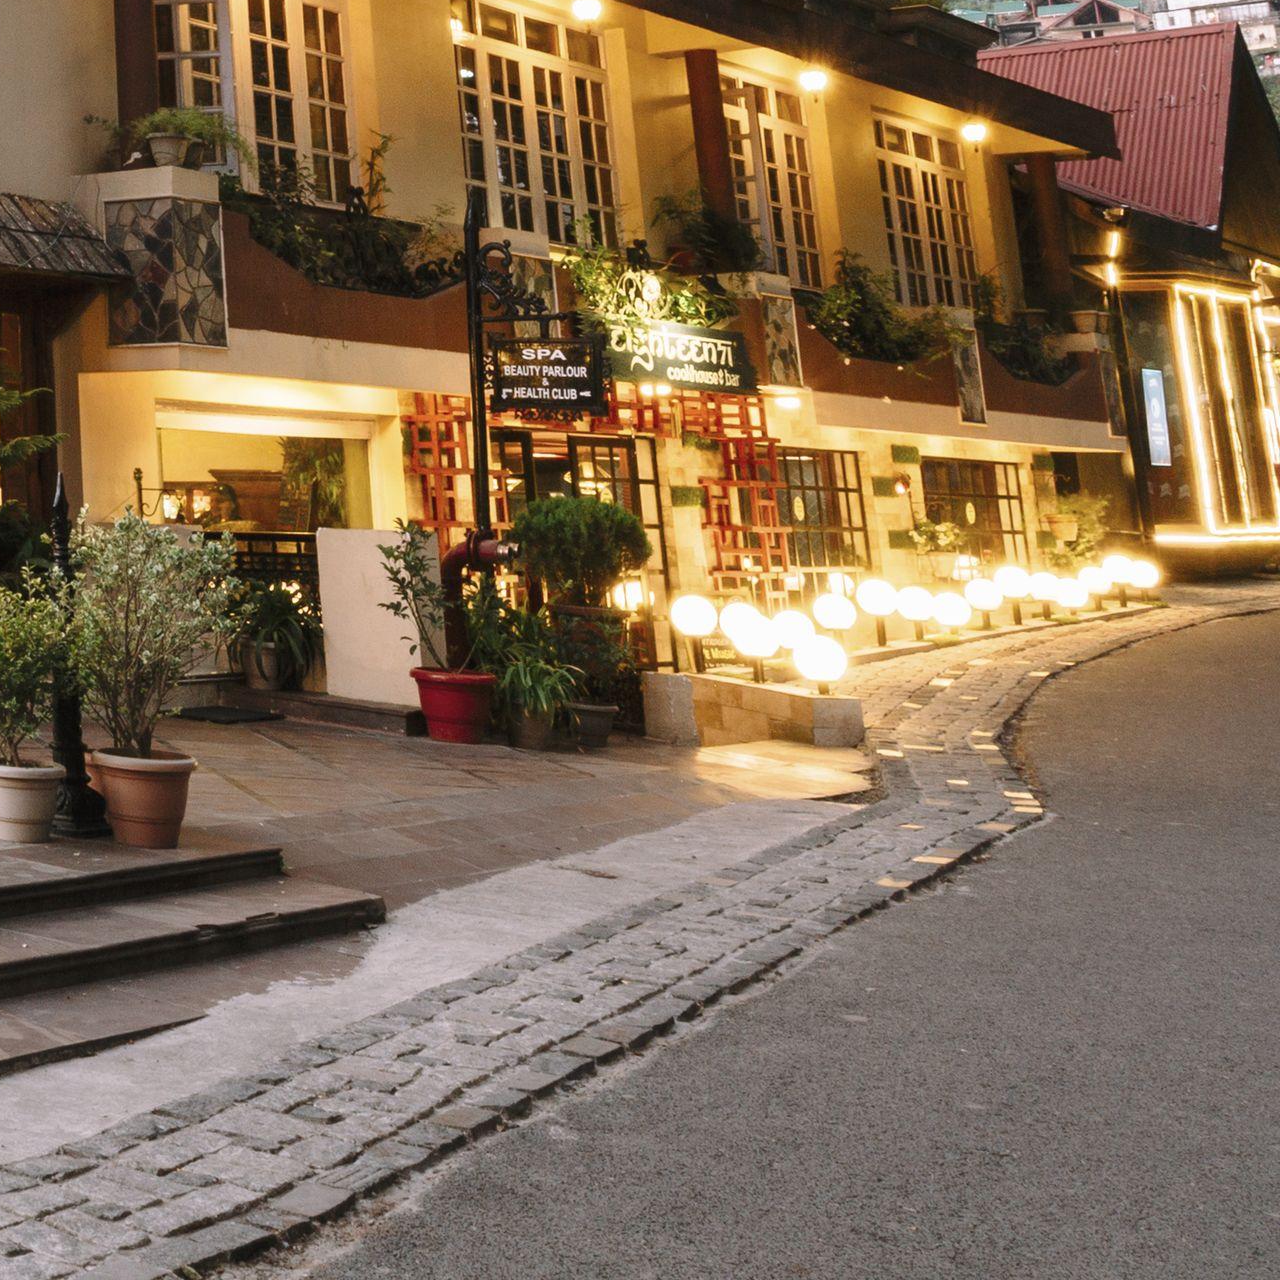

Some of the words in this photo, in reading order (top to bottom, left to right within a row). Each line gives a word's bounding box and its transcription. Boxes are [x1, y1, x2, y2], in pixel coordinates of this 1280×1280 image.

[521, 348, 567, 361] SPA
[503, 365, 541, 376] BEAUTY
[542, 365, 588, 378] PARLOUR
[724, 369, 740, 387] bar
[542, 377, 550, 386] &
[513, 387, 550, 399] HEALTH
[551, 388, 578, 400] CLUB
